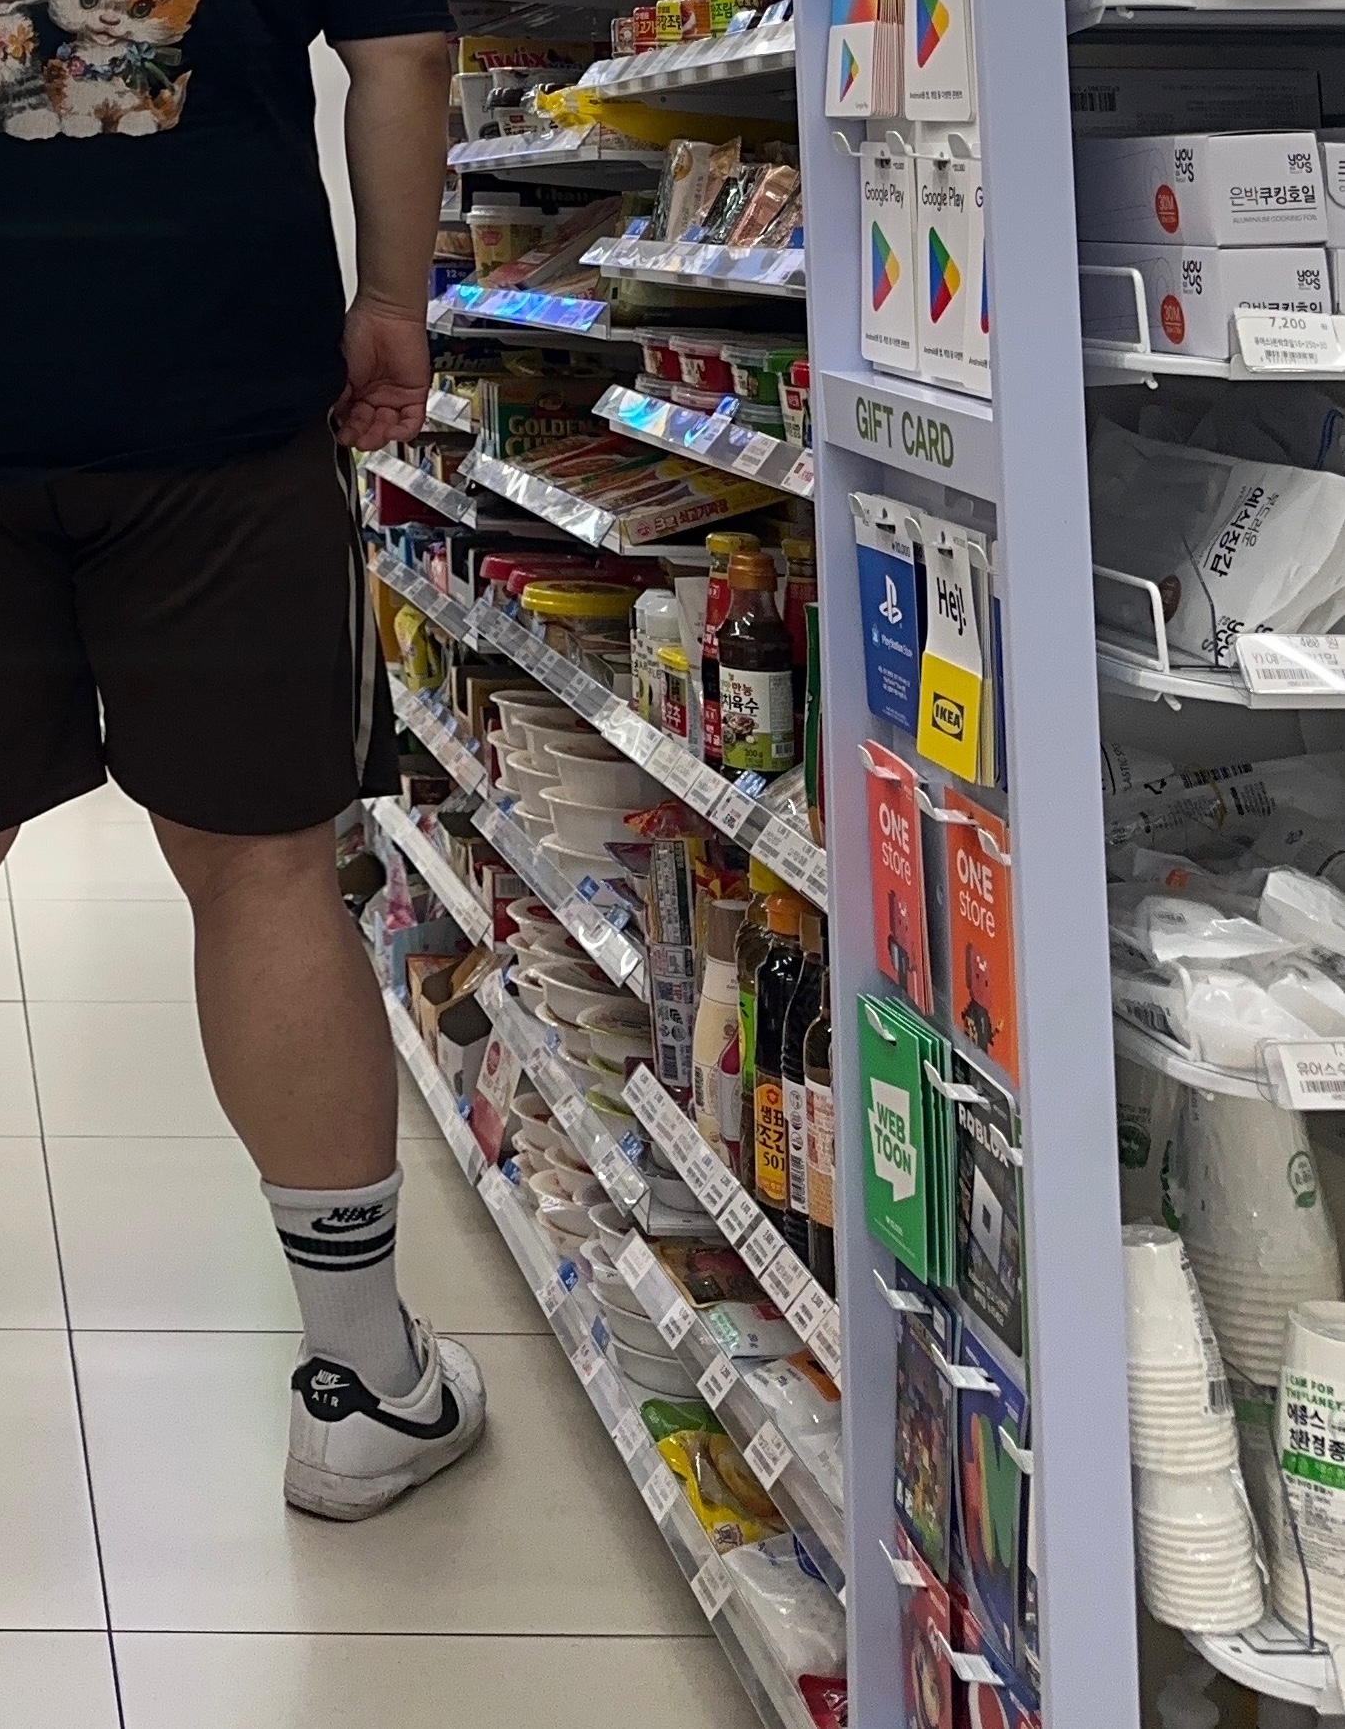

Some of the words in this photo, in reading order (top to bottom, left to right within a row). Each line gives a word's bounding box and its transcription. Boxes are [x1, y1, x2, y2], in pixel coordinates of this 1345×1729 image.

[864, 181, 890, 208] Google
[890, 184, 904, 208] Play
[921, 185, 948, 213] Google
[948, 186, 965, 213] Play
[1229, 184, 1317, 207] 은박쿠킹호일
[1268, 316, 1307, 330] 7,200
[855, 394, 893, 449] GIFT
[900, 415, 955, 469] CARD
[935, 576, 967, 637] Hej!
[934, 702, 962, 730] IKEA
[878, 801, 911, 855] ONE
[880, 840, 912, 888] store
[956, 848, 994, 903] ONE
[958, 892, 996, 939] store
[876, 1101, 905, 1145] WEB
[874, 1125, 912, 1177] TOON
[311, 1390, 340, 1407] AIR
[315, 1368, 343, 1386] NIKE
